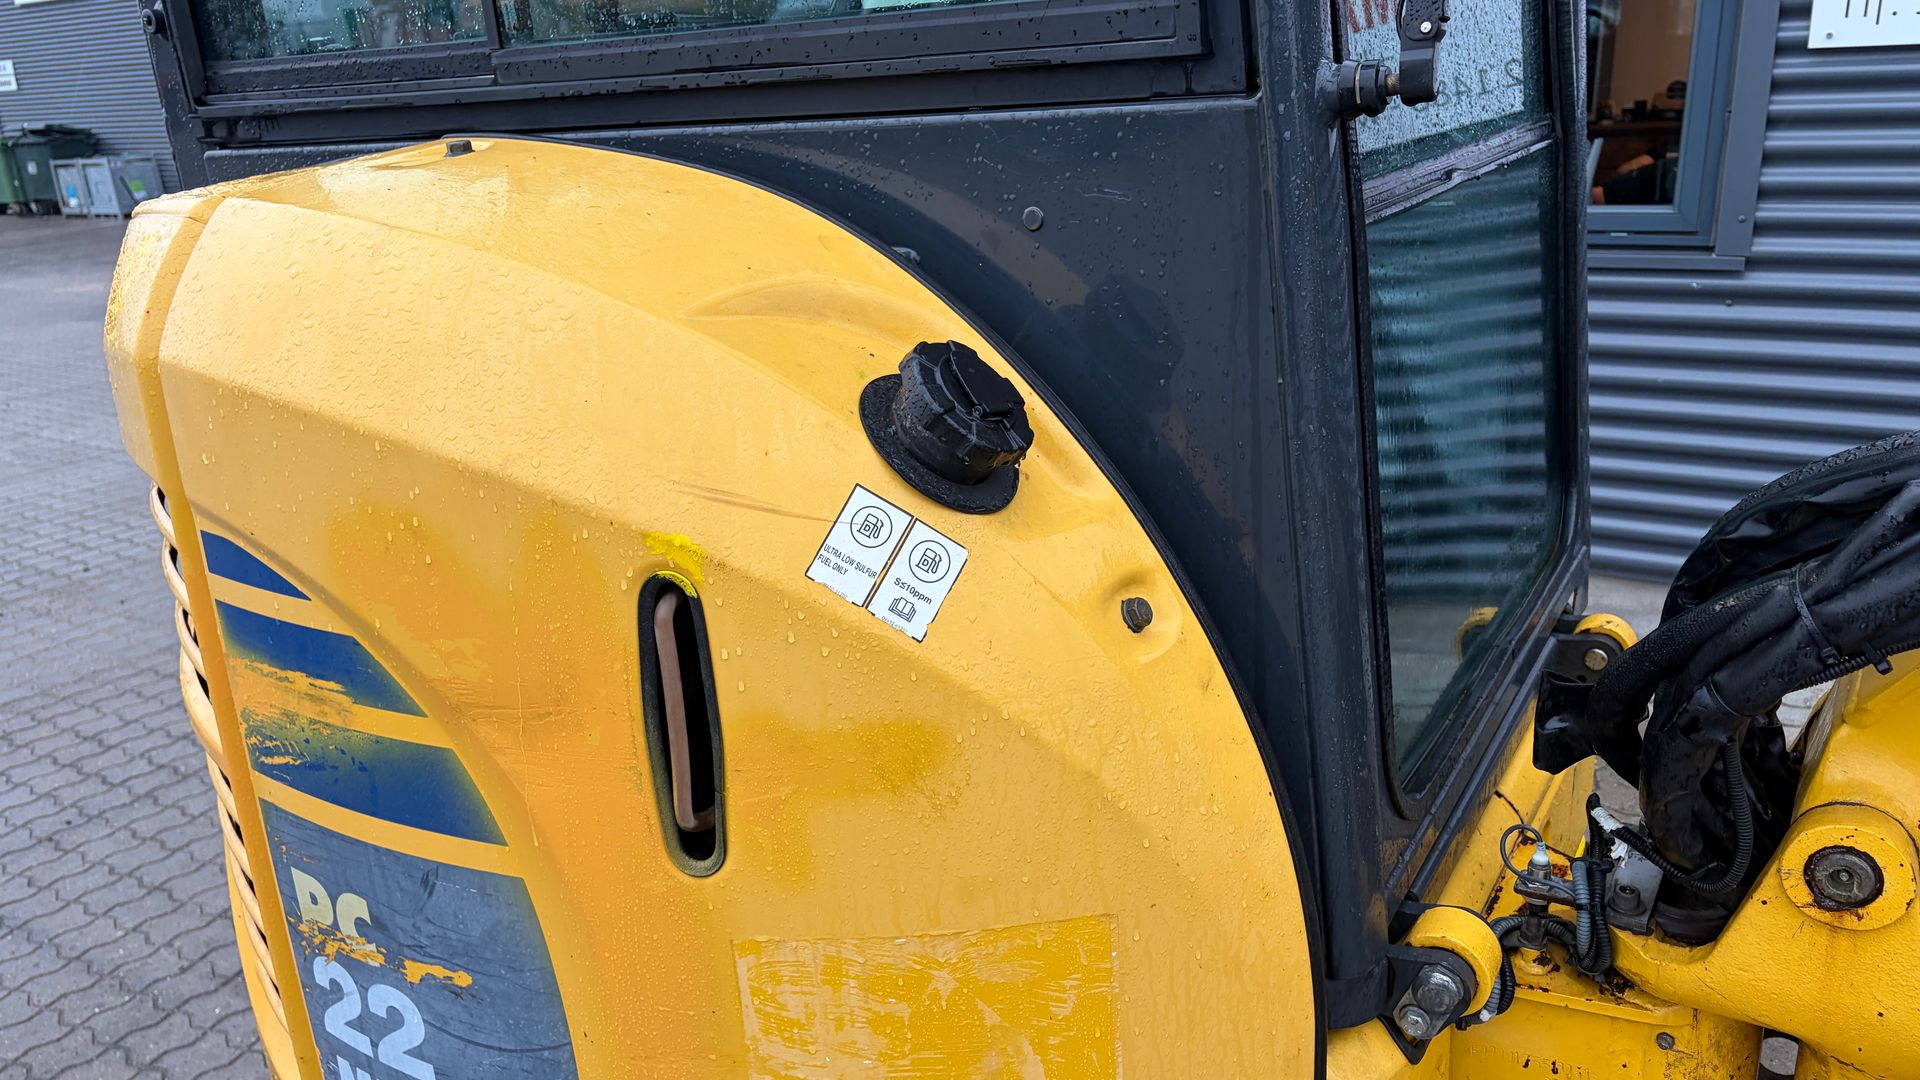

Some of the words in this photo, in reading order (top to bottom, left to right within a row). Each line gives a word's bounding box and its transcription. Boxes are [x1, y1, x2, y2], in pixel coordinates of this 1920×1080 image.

[817, 553, 833, 569] FUEL
[832, 562, 849, 576] ONLY
[823, 543, 842, 559] ULTRA
[841, 553, 856, 567] LOW
[854, 561, 878, 580] SULFUR
[312, 955, 435, 1080] 22
